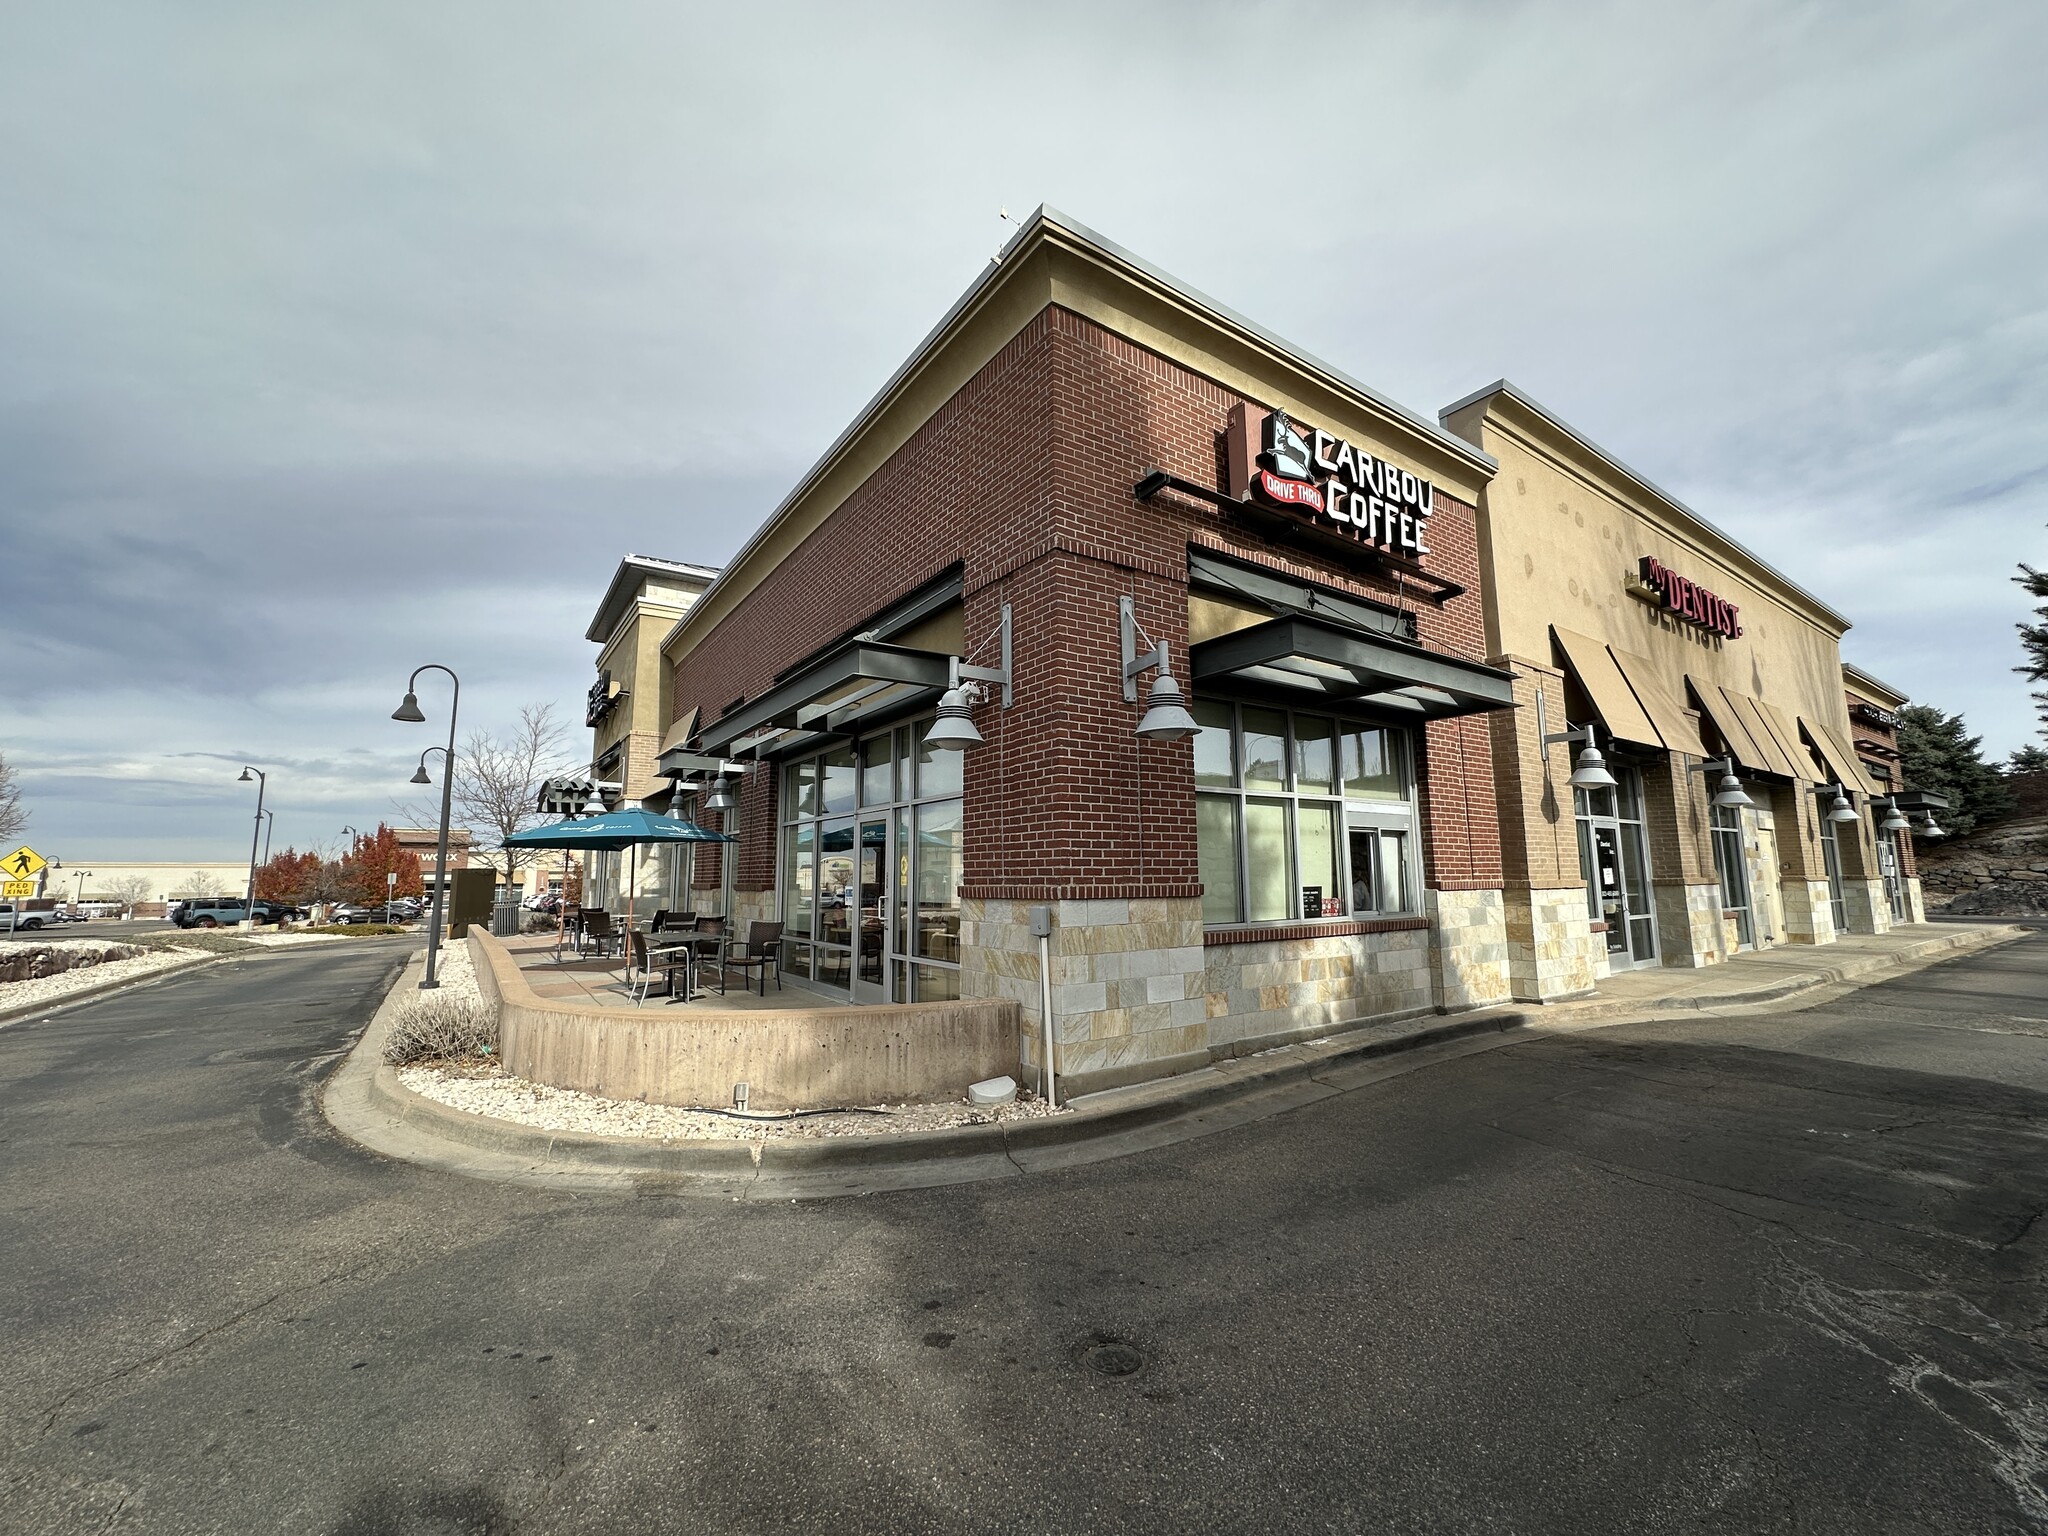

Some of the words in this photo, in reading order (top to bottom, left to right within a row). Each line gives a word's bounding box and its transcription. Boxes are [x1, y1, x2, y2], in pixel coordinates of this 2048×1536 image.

[1266, 474, 1295, 500] DRIVE
[1297, 484, 1321, 508] THRU
[1314, 428, 1433, 517] CARIBOU
[1326, 480, 1431, 553] COFFEE
